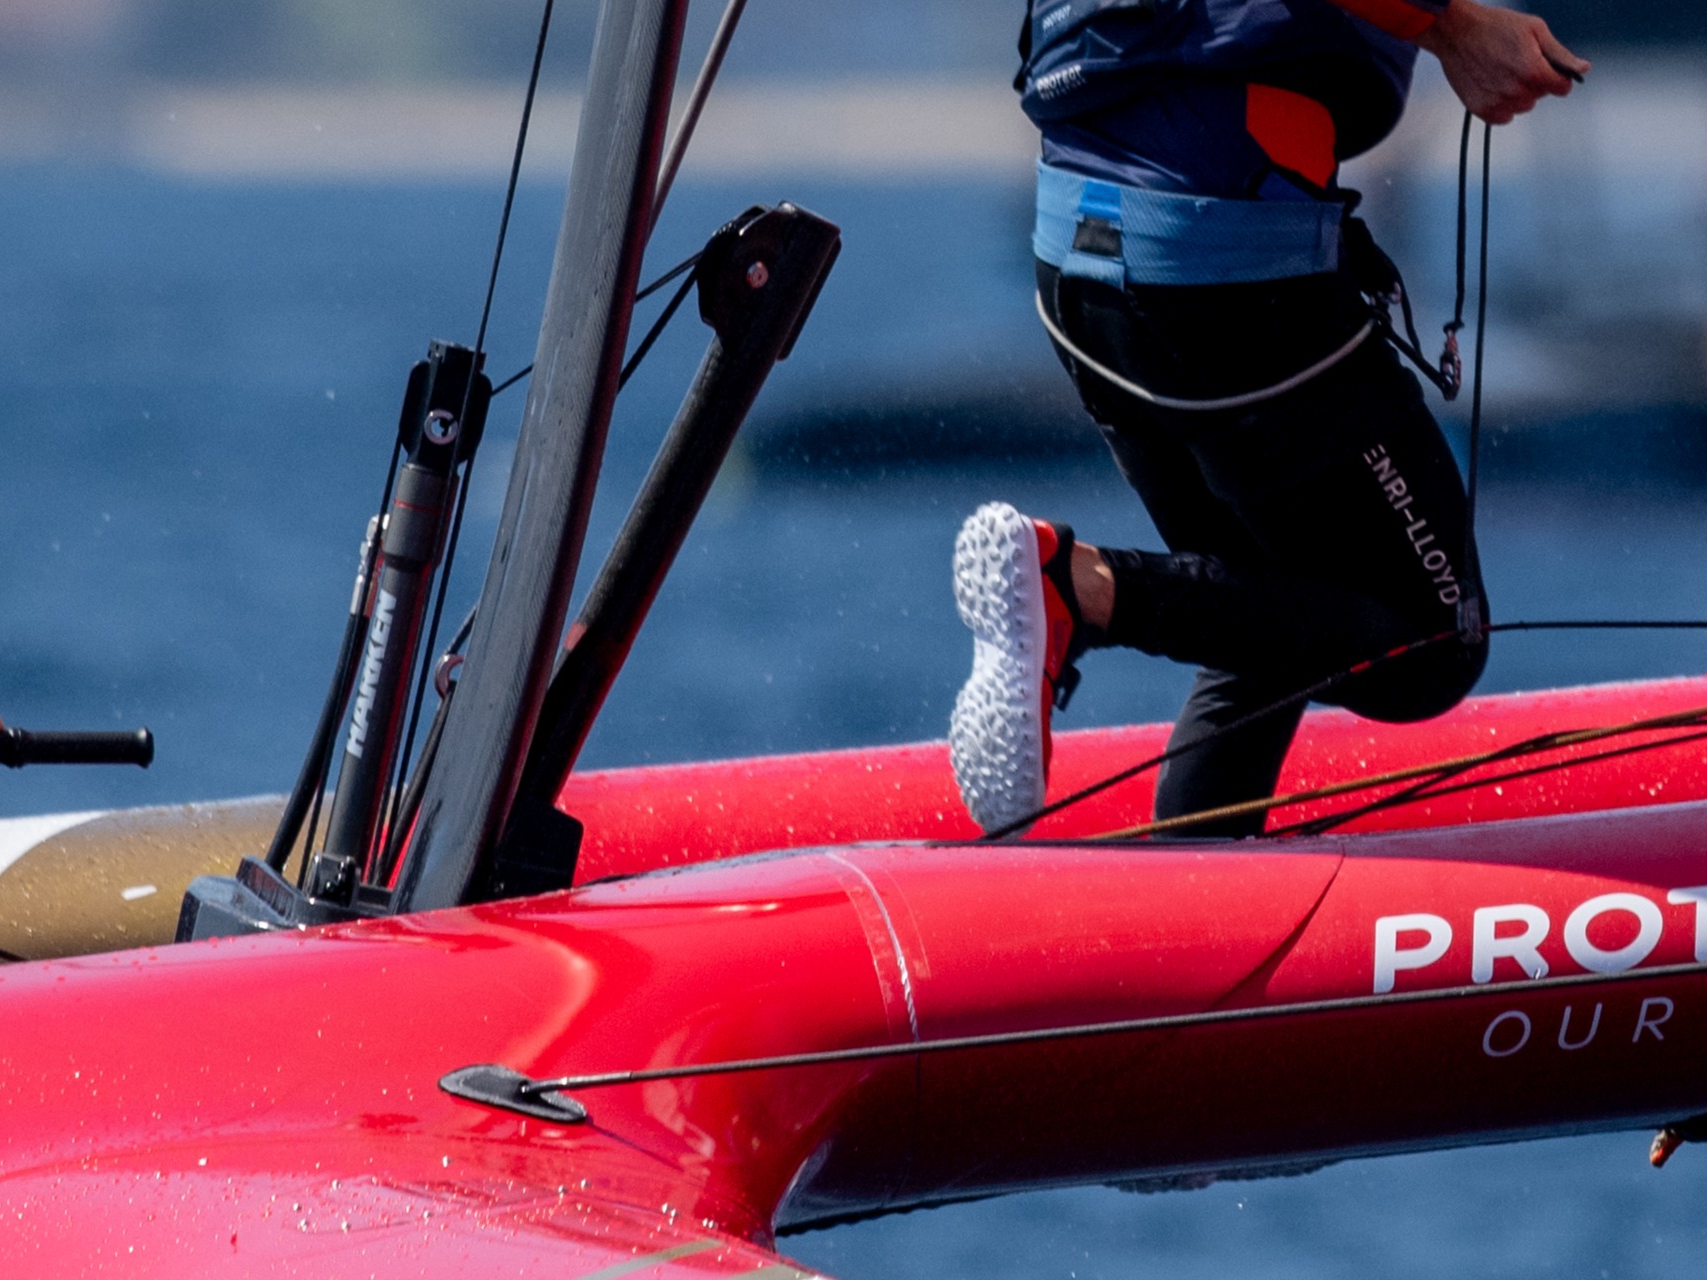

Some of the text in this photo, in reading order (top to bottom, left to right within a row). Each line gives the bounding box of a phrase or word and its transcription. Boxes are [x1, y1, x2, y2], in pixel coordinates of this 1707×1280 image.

[1363, 443, 1461, 606] ENRI-LLOYD
[346, 588, 397, 759] HARKEN
[1481, 996, 1675, 1058] OUR
